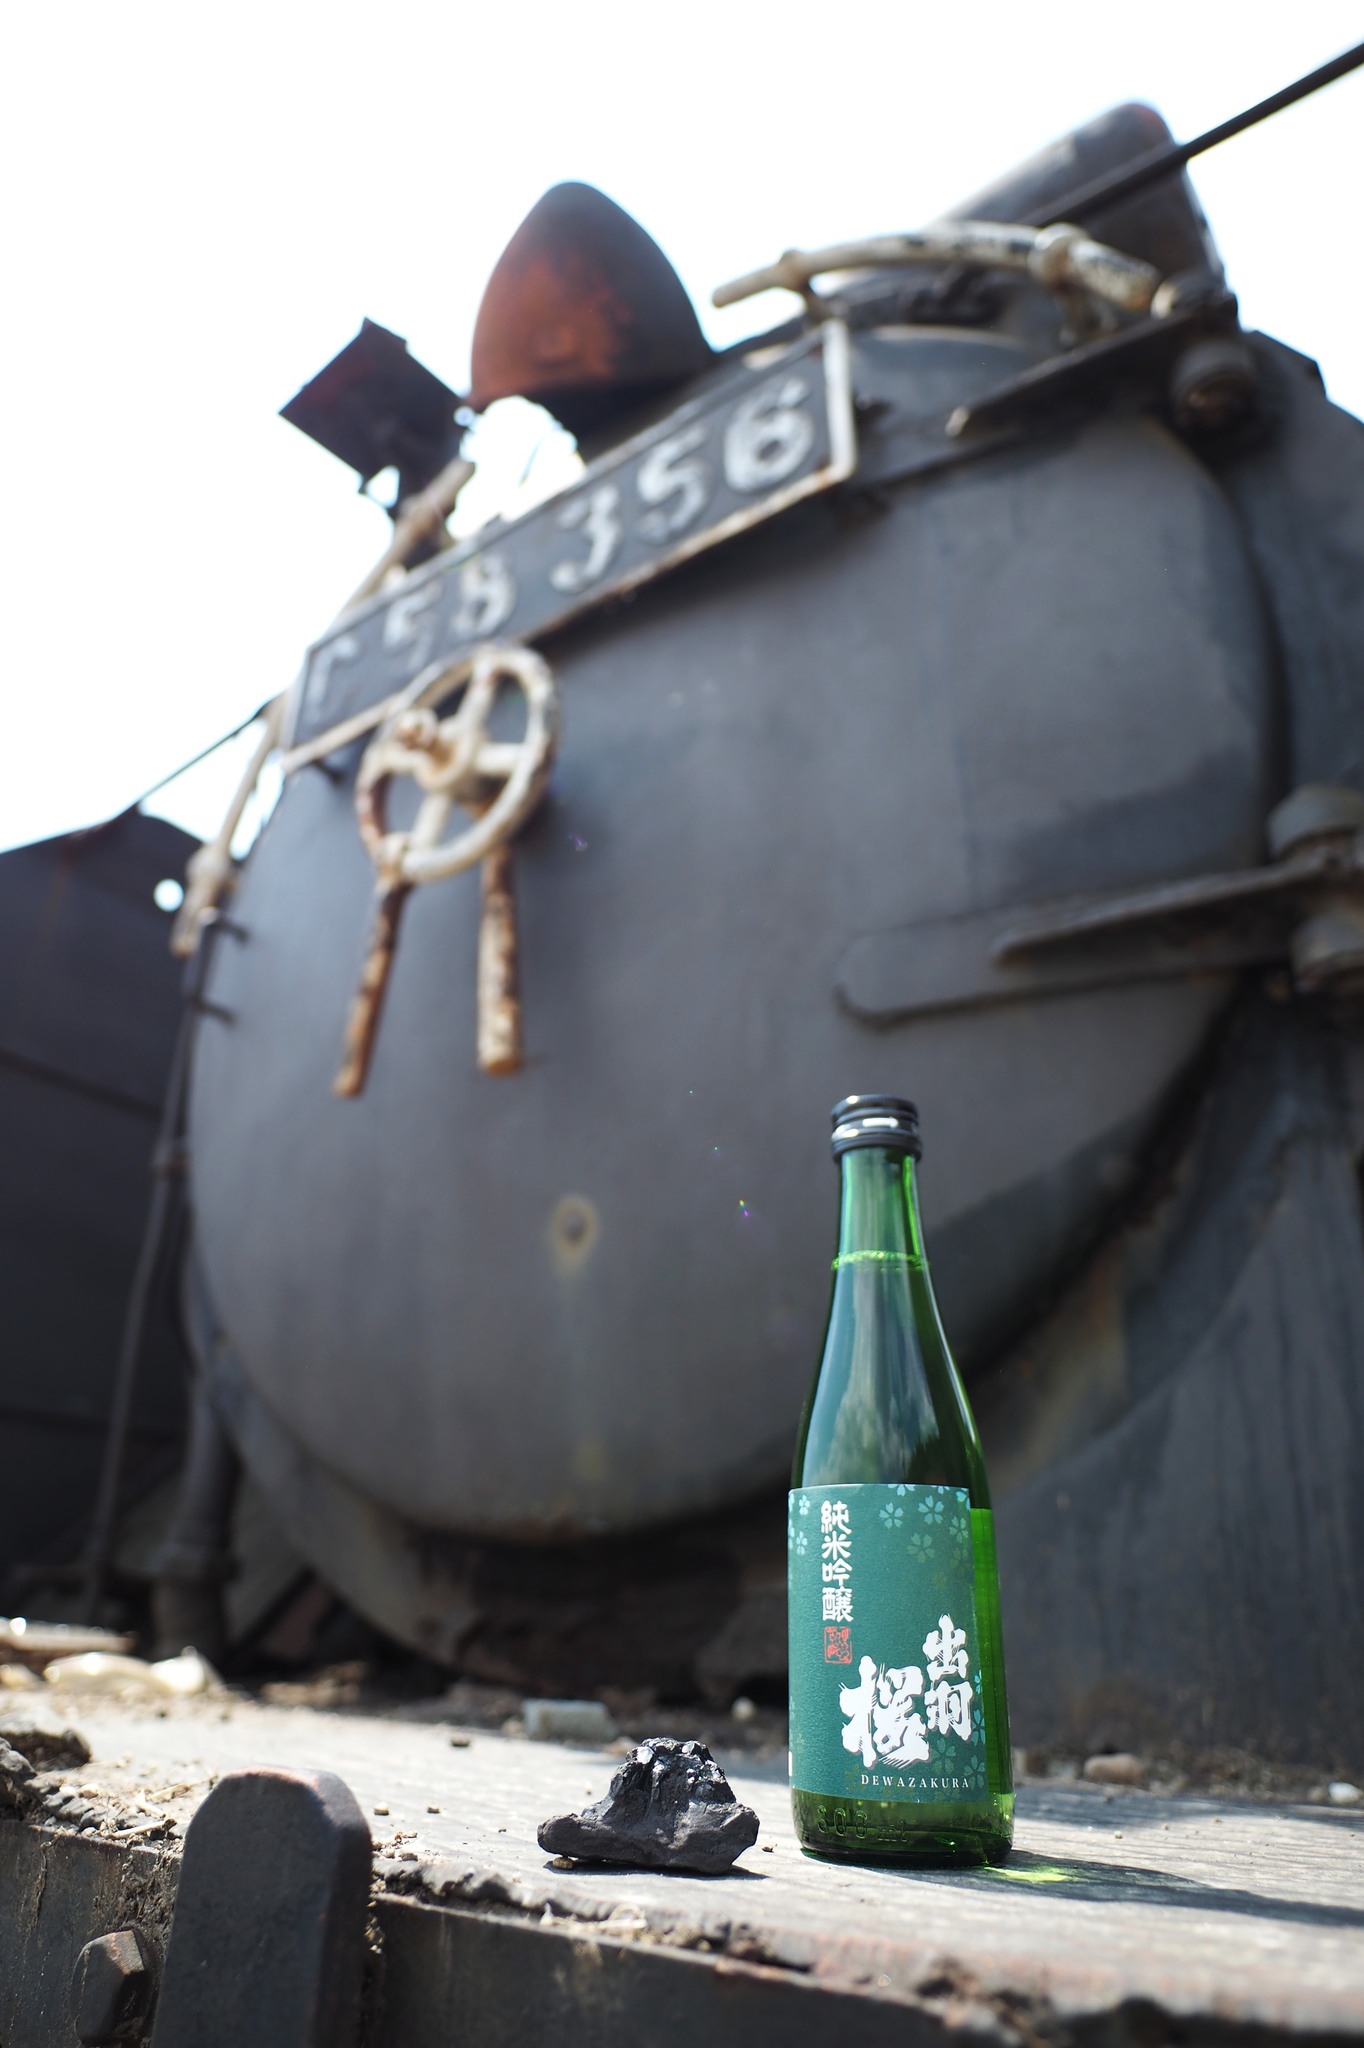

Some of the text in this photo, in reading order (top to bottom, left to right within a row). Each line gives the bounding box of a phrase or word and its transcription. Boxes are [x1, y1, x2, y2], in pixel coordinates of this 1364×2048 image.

[550, 378, 814, 590] 356
[821, 1500, 853, 1623] 純米吟醸
[861, 1774, 969, 1788] DEWAZAKURA
